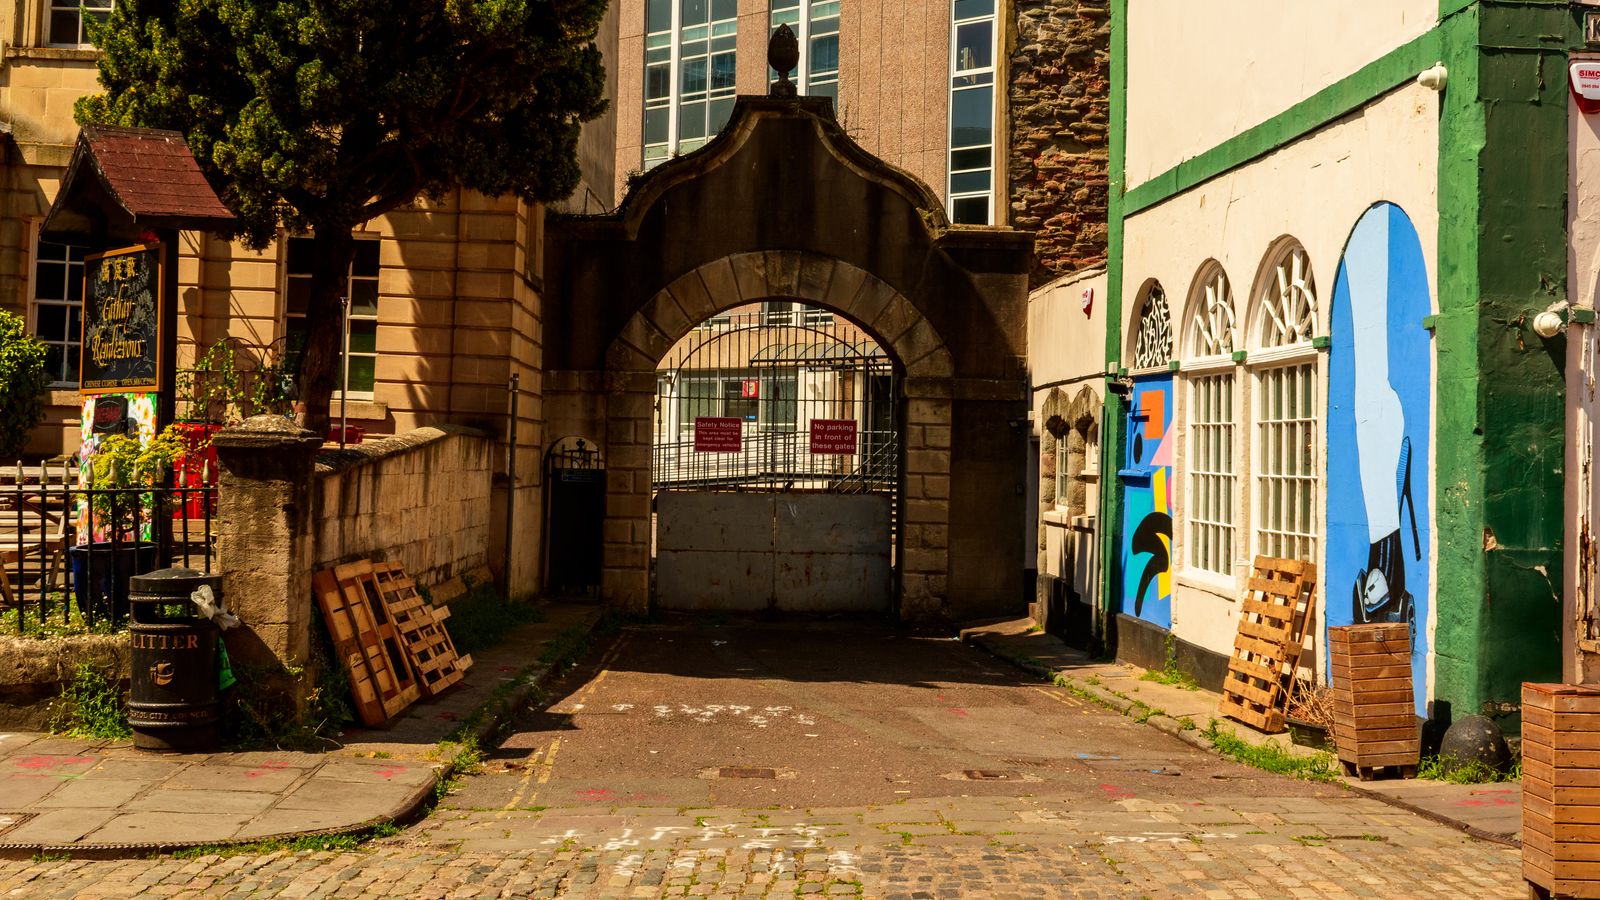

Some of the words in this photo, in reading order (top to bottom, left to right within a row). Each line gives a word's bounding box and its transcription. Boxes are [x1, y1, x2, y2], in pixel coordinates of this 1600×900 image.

[102, 284, 134, 330] Cathay
[91, 325, 144, 368] Rendezvous
[697, 421, 718, 429] Safety
[826, 424, 854, 432] parking
[133, 634, 199, 649] LITTER
